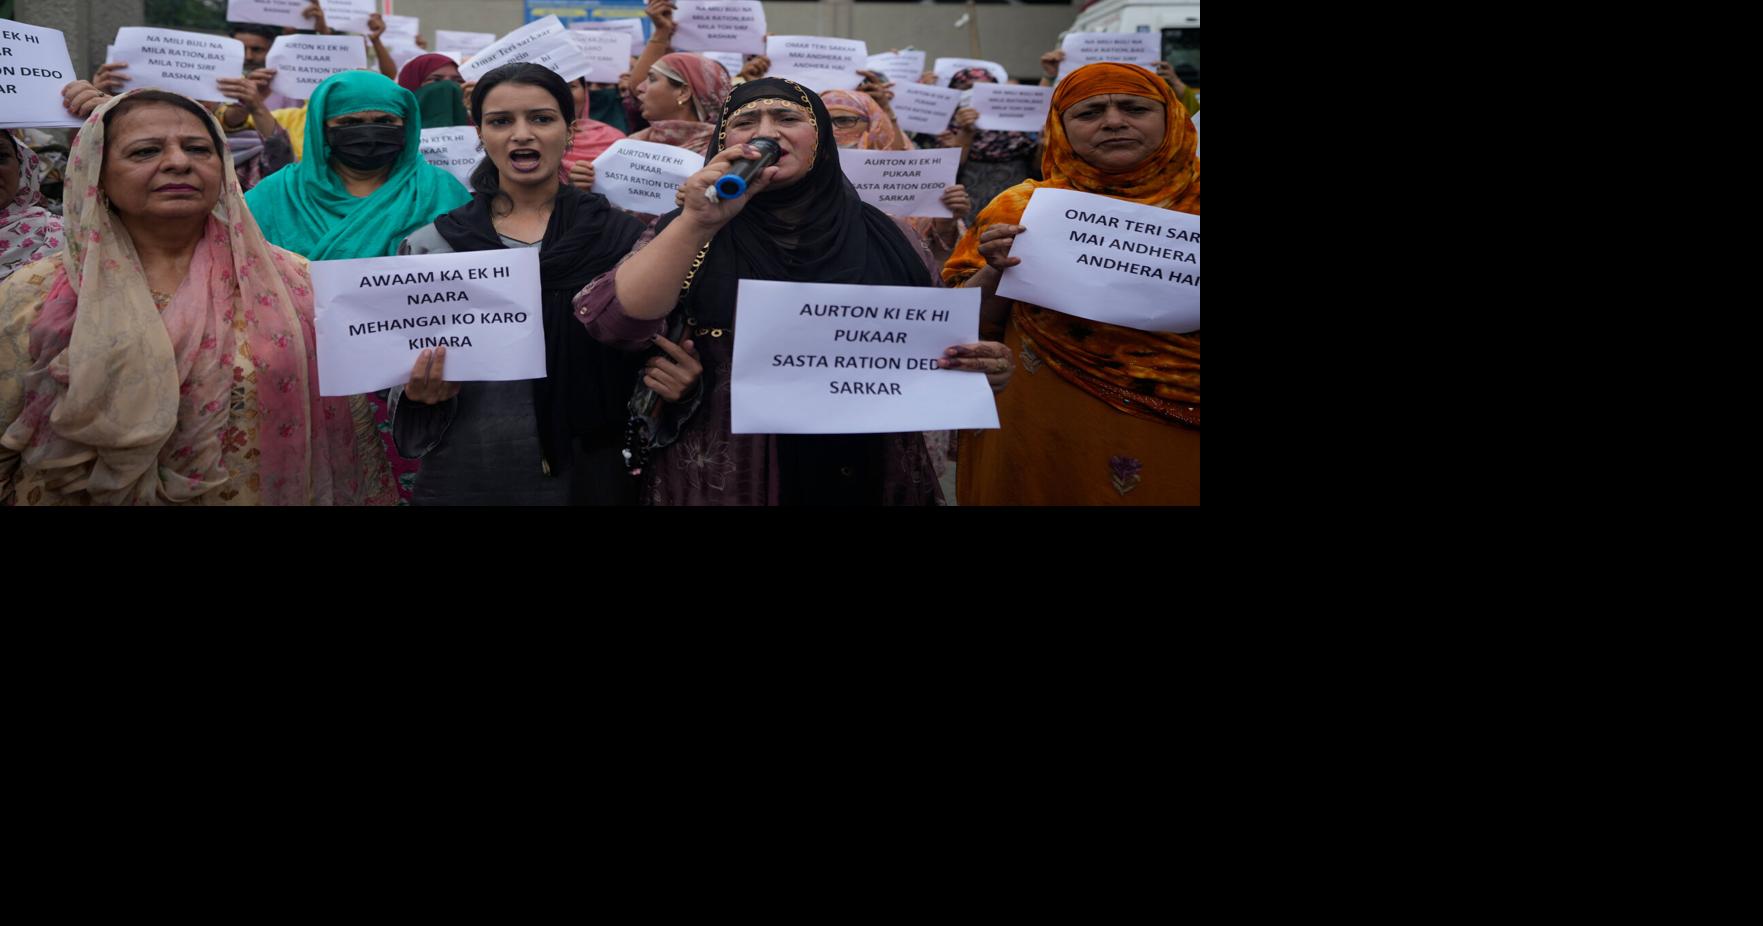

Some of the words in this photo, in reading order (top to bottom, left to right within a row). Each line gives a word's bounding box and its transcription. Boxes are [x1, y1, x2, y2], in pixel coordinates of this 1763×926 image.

[2, 30, 21, 41] EK
[24, 34, 39, 44] HI
[0, 47, 13, 56] R
[141, 46, 166, 55] MILA
[148, 58, 172, 67] MILA
[471, 54, 496, 69] Omar
[0, 66, 15, 76] N
[20, 67, 62, 79] DEDO
[161, 71, 200, 81] BASHAN
[617, 148, 650, 160] AURTON
[630, 162, 662, 175] PUKAAR
[604, 171, 628, 181] SASTA
[630, 176, 661, 188] RATION
[664, 182, 680, 191] DED
[628, 187, 662, 199] SARKAR
[1065, 209, 1119, 228] OMAR
[1125, 220, 1162, 236] TERI
[1069, 230, 1105, 246] MAI
[1109, 239, 1196, 264] ANDHERA
[359, 271, 434, 288] AWAAM
[440, 269, 462, 282] KA
[468, 267, 488, 280] EK
[493, 266, 510, 278] HI
[1077, 254, 1163, 280] ANDHERA
[1168, 271, 1200, 286] HAI
[407, 291, 469, 305] NAARA
[799, 303, 879, 319] AURTON
[883, 307, 900, 320] KI
[905, 308, 926, 321] EK
[931, 309, 949, 322] HI
[349, 315, 446, 336] MEHANGAI
[452, 313, 475, 325] KO
[480, 312, 527, 324] KARO
[409, 336, 472, 350] KINARA
[834, 329, 908, 344] PUKAAR
[772, 354, 828, 368] SASTA
[834, 356, 901, 370] RATION
[907, 358, 940, 370] DED
[829, 381, 902, 396] SARKAR
